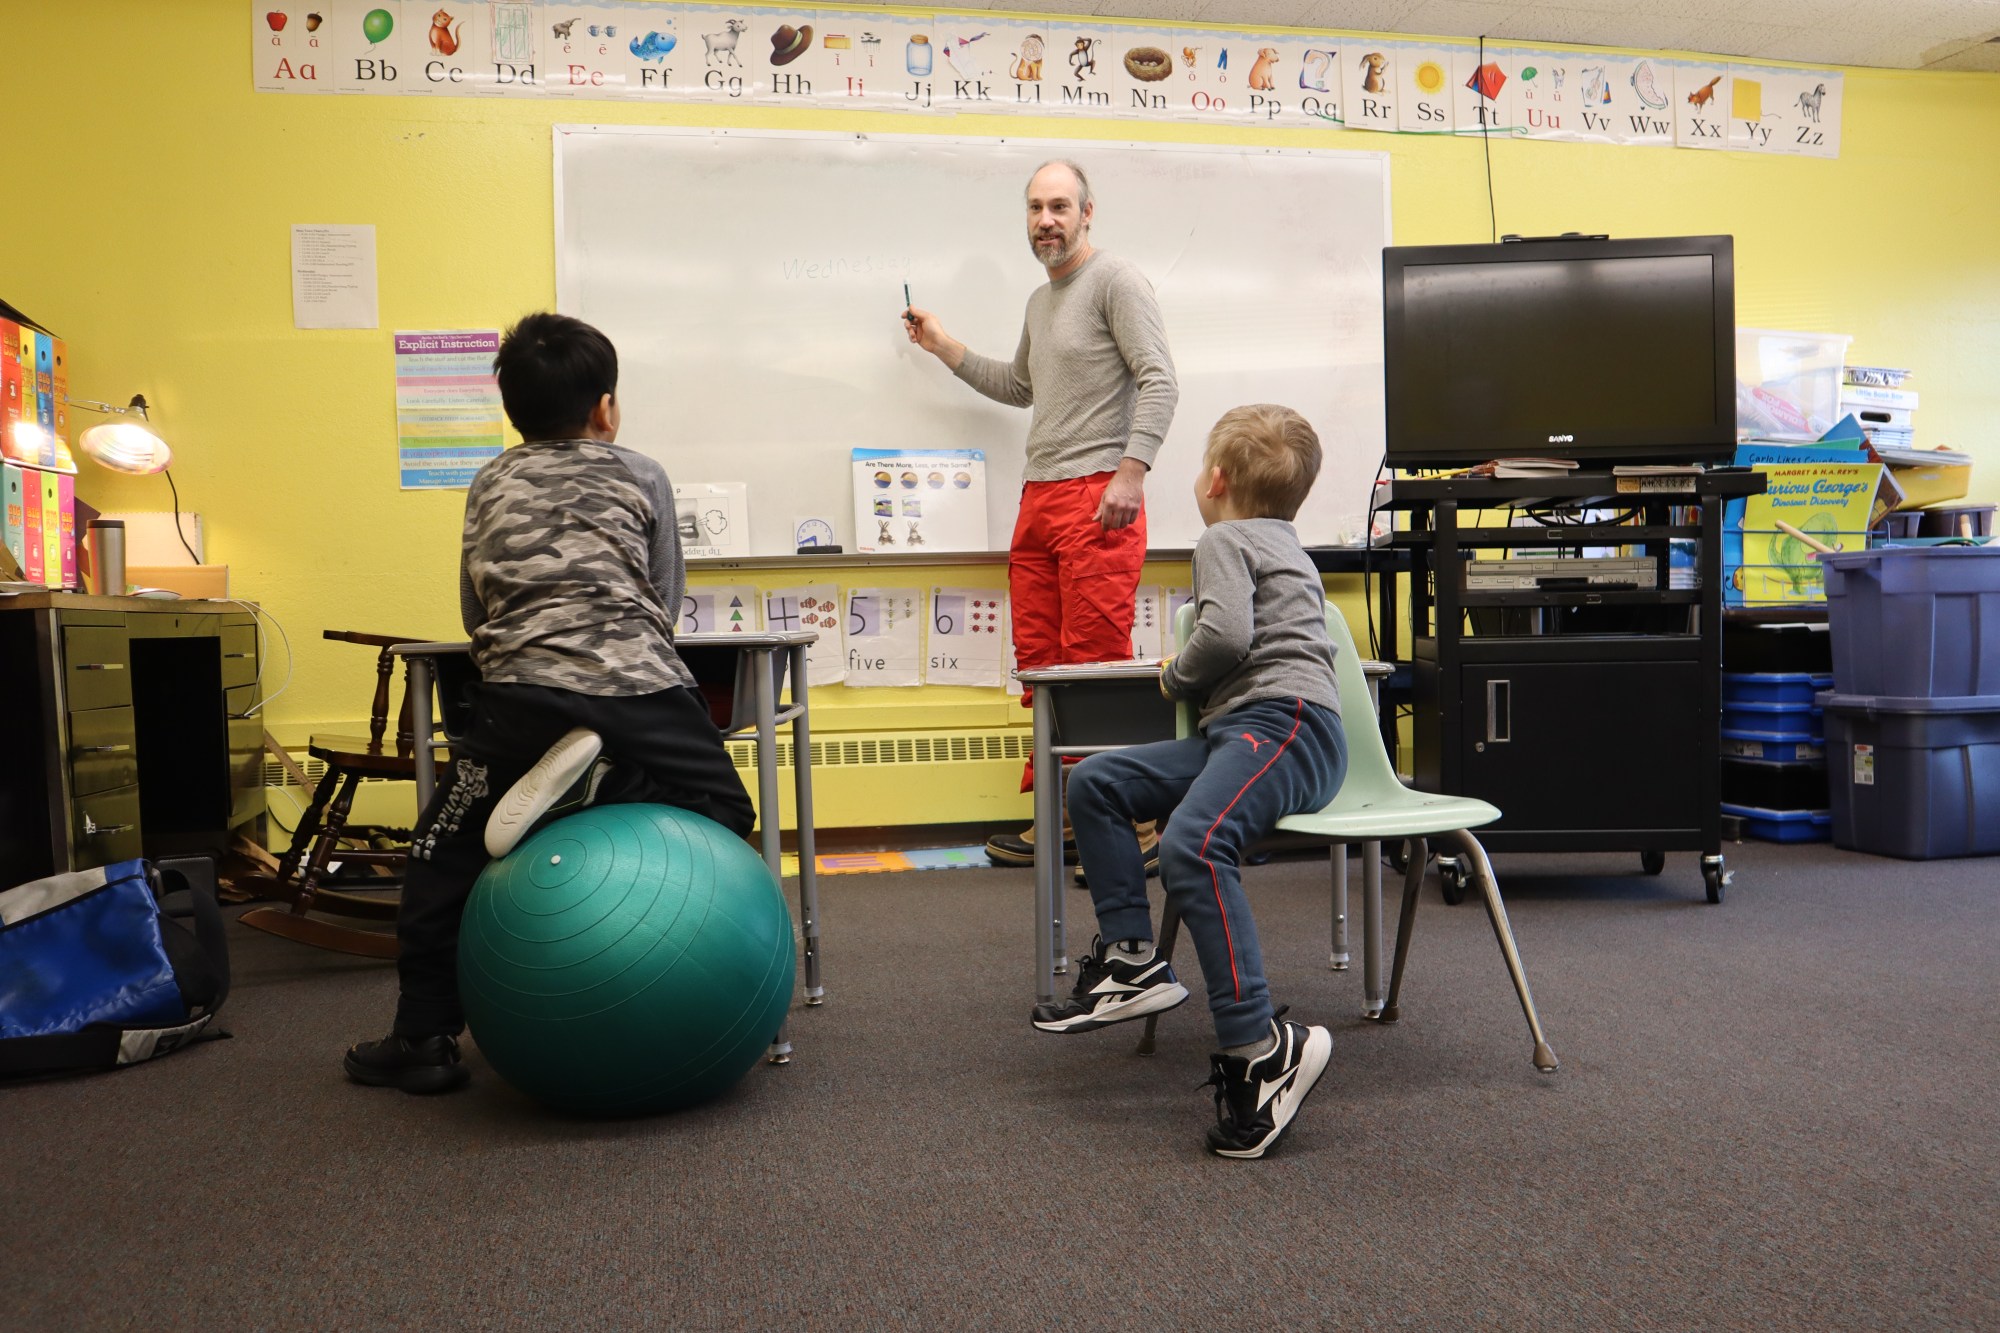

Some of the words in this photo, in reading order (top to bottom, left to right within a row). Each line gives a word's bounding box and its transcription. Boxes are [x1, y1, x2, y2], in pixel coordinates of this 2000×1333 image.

[273, 57, 317, 82] Aa
[354, 58, 398, 82] Bb
[424, 60, 464, 83] Cc
[493, 62, 537, 85] Dd
[567, 64, 605, 87] Ee
[641, 67, 672, 89] Ff
[704, 72, 743, 97] Gg
[771, 72, 812, 95] Hh
[845, 76, 864, 97] Ii
[905, 80, 932, 108] Jj
[953, 78, 992, 100] Kk
[1016, 83, 1042, 104] Ll
[1061, 84, 1110, 107] Mm
[1130, 88, 1167, 109] Nn
[1191, 91, 1225, 111] Oo
[1249, 94, 1282, 119] Pp
[1302, 97, 1337, 121] Qq
[1362, 98, 1391, 119] Rr
[1417, 102, 1445, 122] Ss
[1473, 106, 1499, 125] Tt
[1527, 108, 1561, 129] Uu
[1581, 112, 1611, 132] Vv
[1629, 115, 1671, 135] Ww
[1690, 118, 1722, 139] Xx
[1745, 122, 1773, 146] Yy
[1797, 125, 1824, 146] Zz
[399, 340, 439, 351] Explicit
[441, 339, 495, 349] Instruction
[1548, 434, 1574, 443] SANYO
[1749, 453, 1774, 464] Carlo
[1776, 455, 1801, 464] Likes
[1812, 468, 1818, 476] &
[1813, 479, 1868, 497] George's
[1772, 498, 1807, 508] Dinosaur
[1810, 496, 1849, 508] Discovery
[683, 595, 698, 632] 3
[768, 597, 799, 631] 4
[849, 596, 868, 636] 5
[935, 594, 953, 634] 6
[849, 648, 886, 670] five
[930, 652, 958, 670] six
